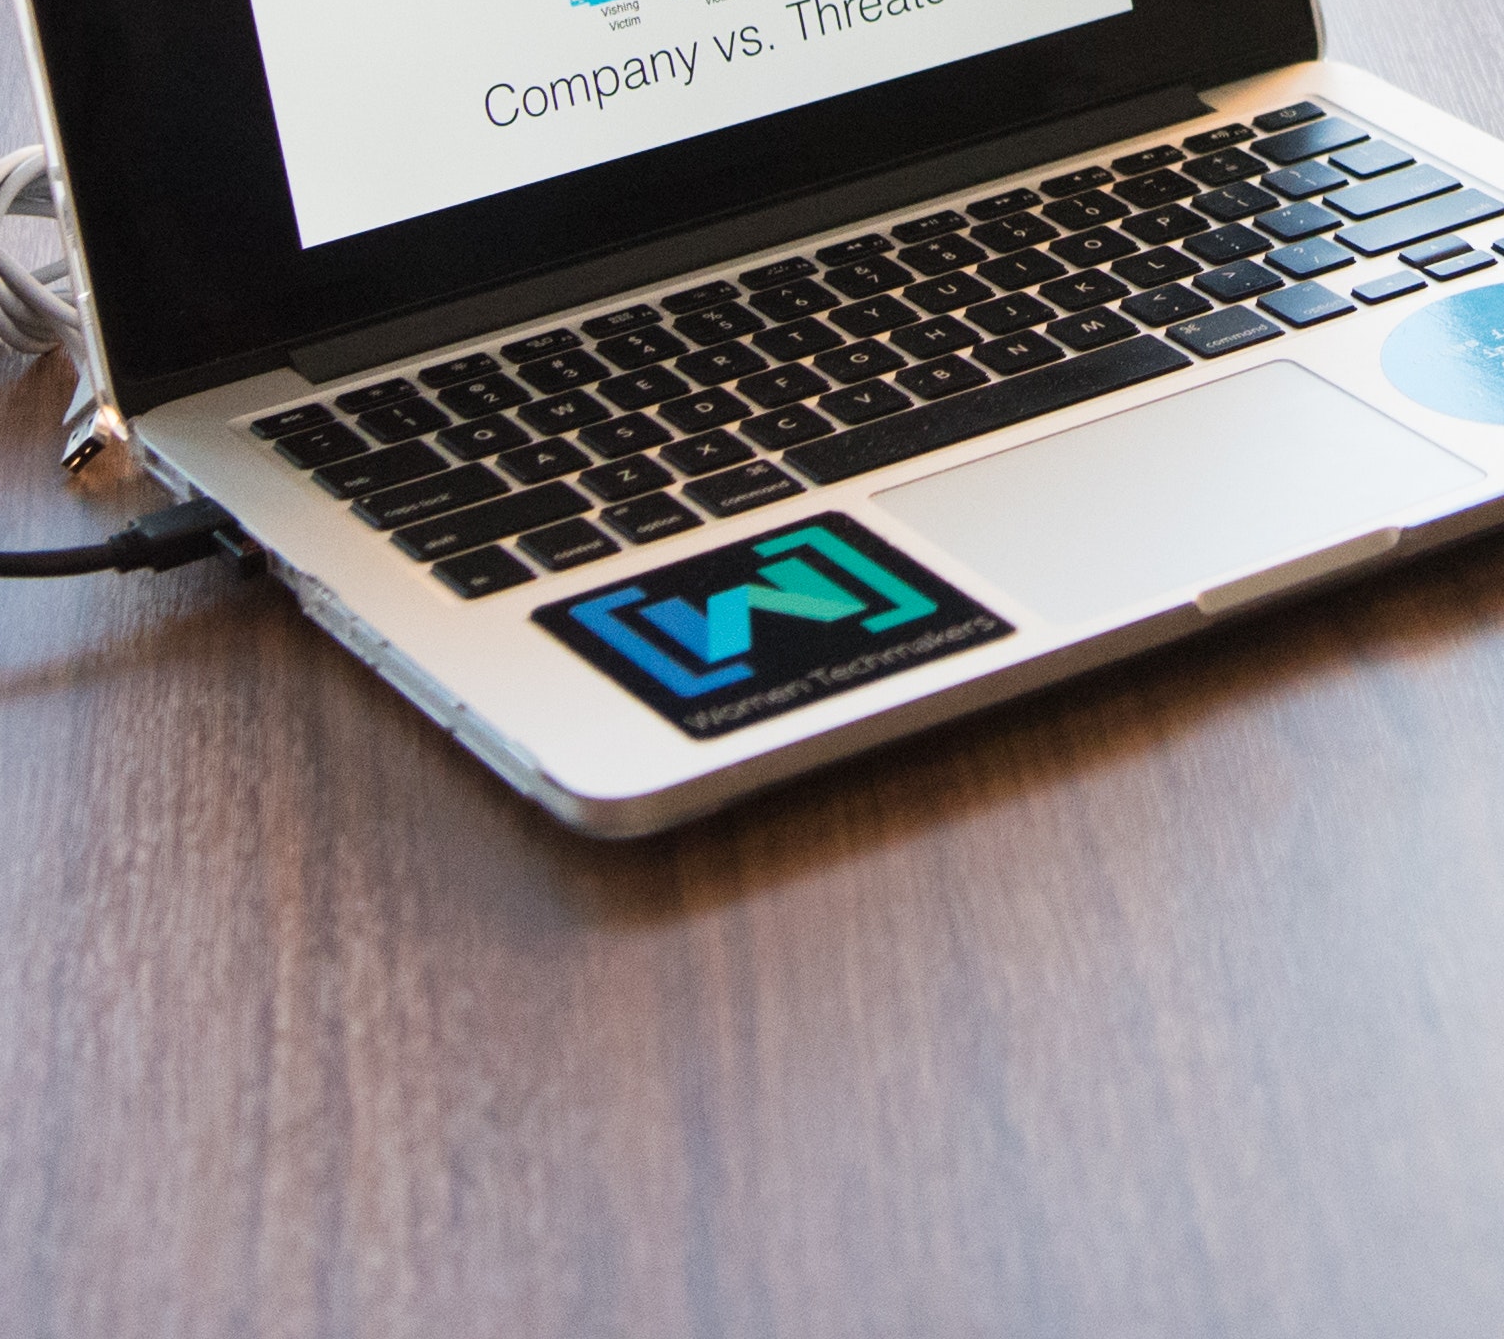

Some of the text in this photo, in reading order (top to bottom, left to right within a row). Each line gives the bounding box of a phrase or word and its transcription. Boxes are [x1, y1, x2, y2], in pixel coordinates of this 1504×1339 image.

[484, 41, 698, 127] Company
[712, 25, 776, 64] vs.
[600, 0, 640, 18] Vishing
[608, 15, 642, 31] Victim
[483, 393, 500, 403] 2
[562, 369, 579, 378] 3
[643, 345, 656, 354] 4
[719, 321, 734, 330] 5
[796, 297, 808, 307] 6
[867, 273, 880, 283] 7
[942, 252, 957, 261] 8
[1014, 229, 1027, 239] 9
[1085, 207, 1100, 216] 0
[538, 453, 556, 465] A
[616, 427, 634, 438] S
[694, 403, 714, 413] D
[774, 377, 789, 389] F
[850, 353, 869, 363] G
[924, 329, 946, 341] H
[1006, 306, 1018, 316] J
[1074, 282, 1095, 293] K
[1148, 260, 1166, 269] L
[550, 403, 575, 417] W
[636, 379, 652, 390] E
[712, 355, 732, 367] R
[788, 331, 804, 342] T
[864, 307, 880, 318] Y
[938, 284, 958, 295] U
[1016, 261, 1027, 271] I
[1084, 239, 1102, 249] O
[1156, 217, 1170, 228] P
[616, 469, 638, 481] Z
[697, 443, 718, 455] X
[778, 418, 796, 429] C
[854, 392, 871, 404] V
[932, 369, 950, 380] B
[1007, 343, 1030, 356] N
[1080, 320, 1106, 333] M
[722, 480, 791, 507] command
[1205, 323, 1269, 349] command
[808, 615, 994, 685] Techmakers
